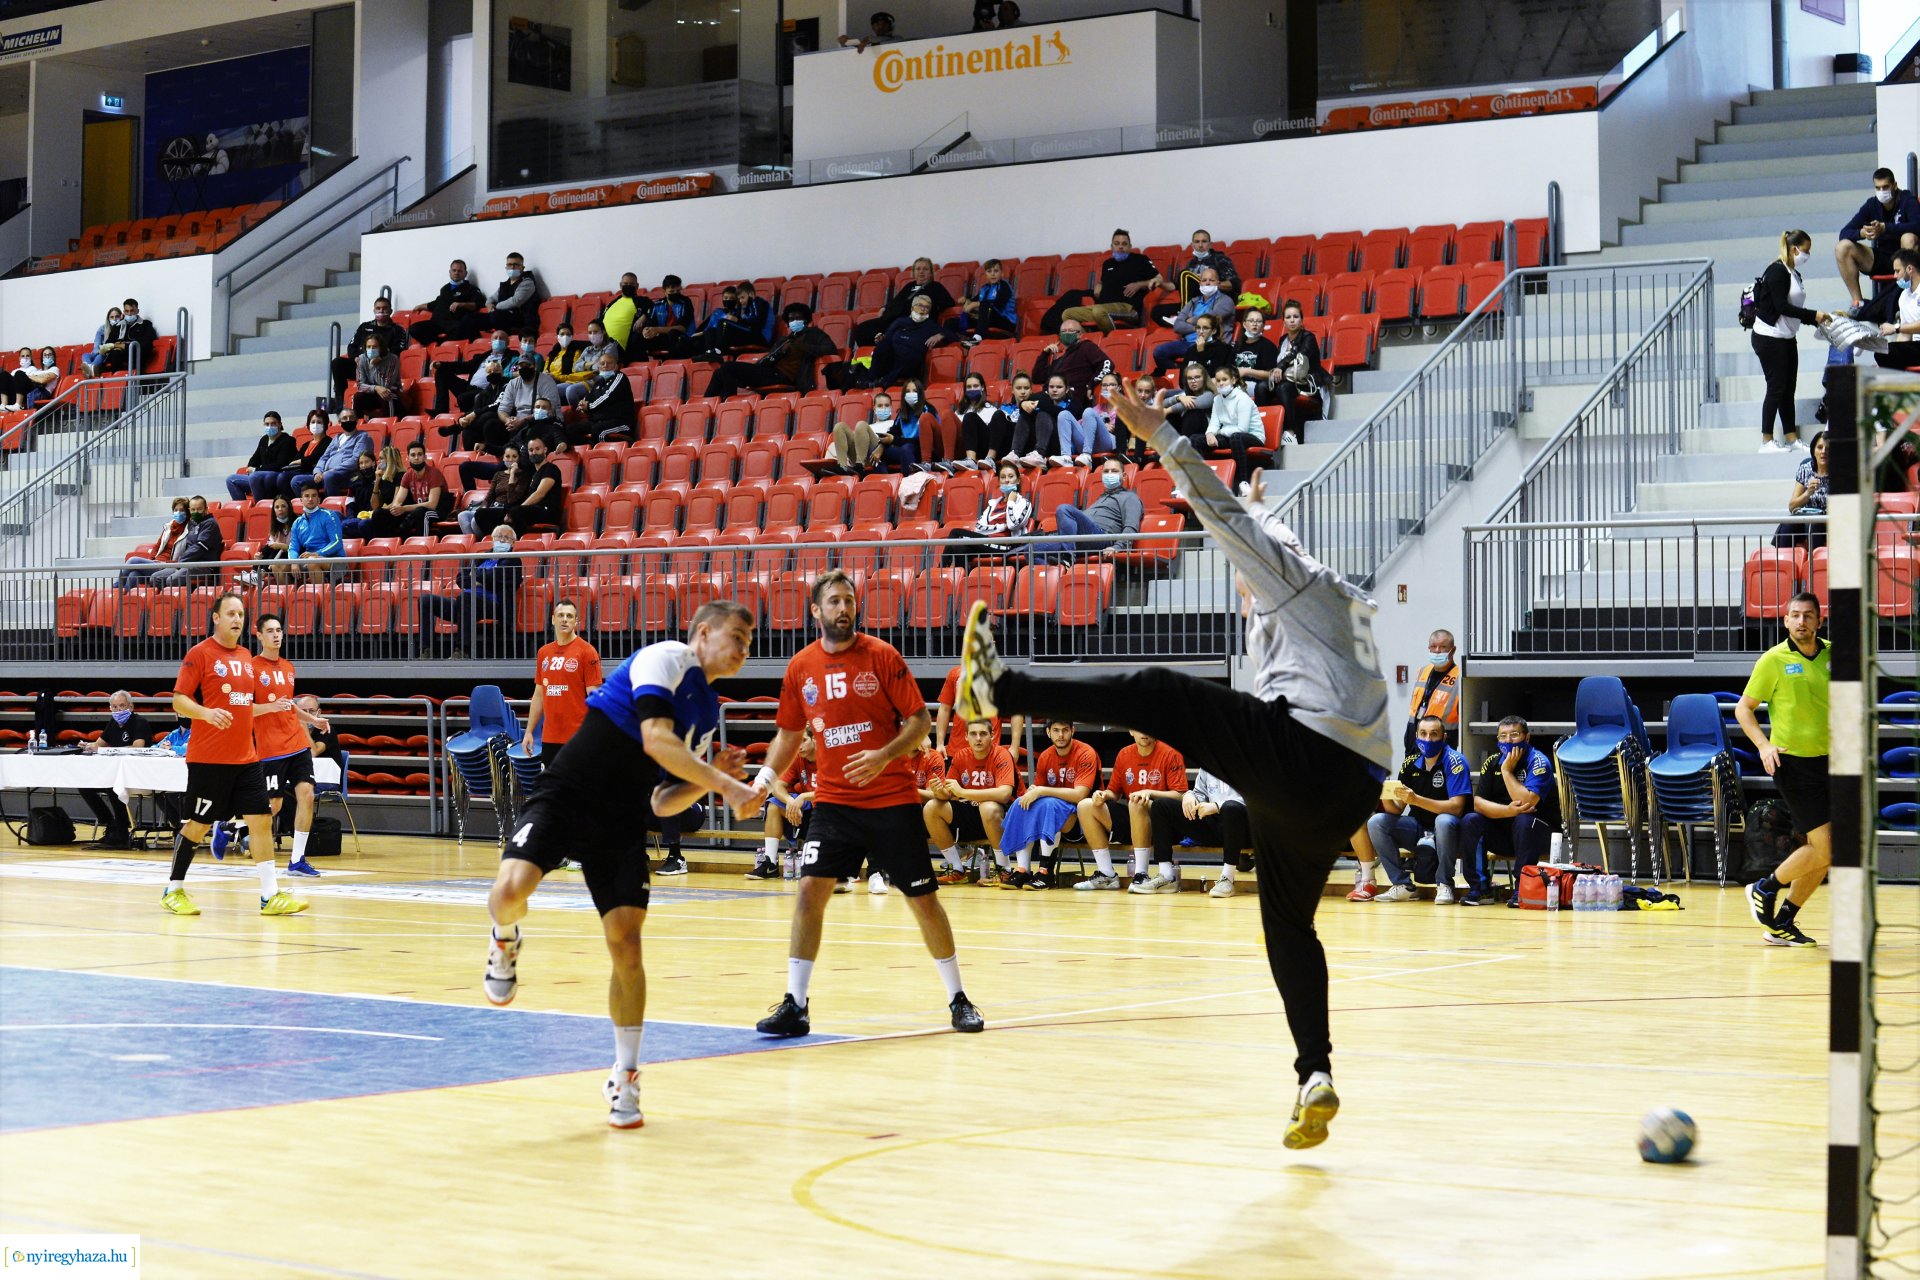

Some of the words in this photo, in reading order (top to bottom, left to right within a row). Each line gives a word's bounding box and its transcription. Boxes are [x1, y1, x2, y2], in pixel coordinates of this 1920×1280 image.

[3, 29, 60, 50] MICHELIN
[873, 34, 1043, 93] Continental
[1490, 91, 1563, 114] Continental
[1369, 103, 1439, 126] Continental
[927, 149, 987, 168] Continental
[826, 159, 884, 179] Continental
[730, 171, 785, 187] Continental
[549, 190, 599, 209] Continental
[637, 182, 690, 200] Continental
[228, 660, 241, 676] 17
[550, 656, 565, 671] 28
[273, 671, 285, 685] 14
[825, 672, 847, 700] 15
[1442, 675, 1456, 686] 26
[824, 722, 872, 738] OPTIMUM
[825, 734, 860, 747] SOLAR
[266, 775, 279, 790] 14
[1138, 769, 1147, 785] 8
[194, 798, 212, 816] 17
[512, 822, 534, 848] 4
[801, 841, 821, 867] 15
